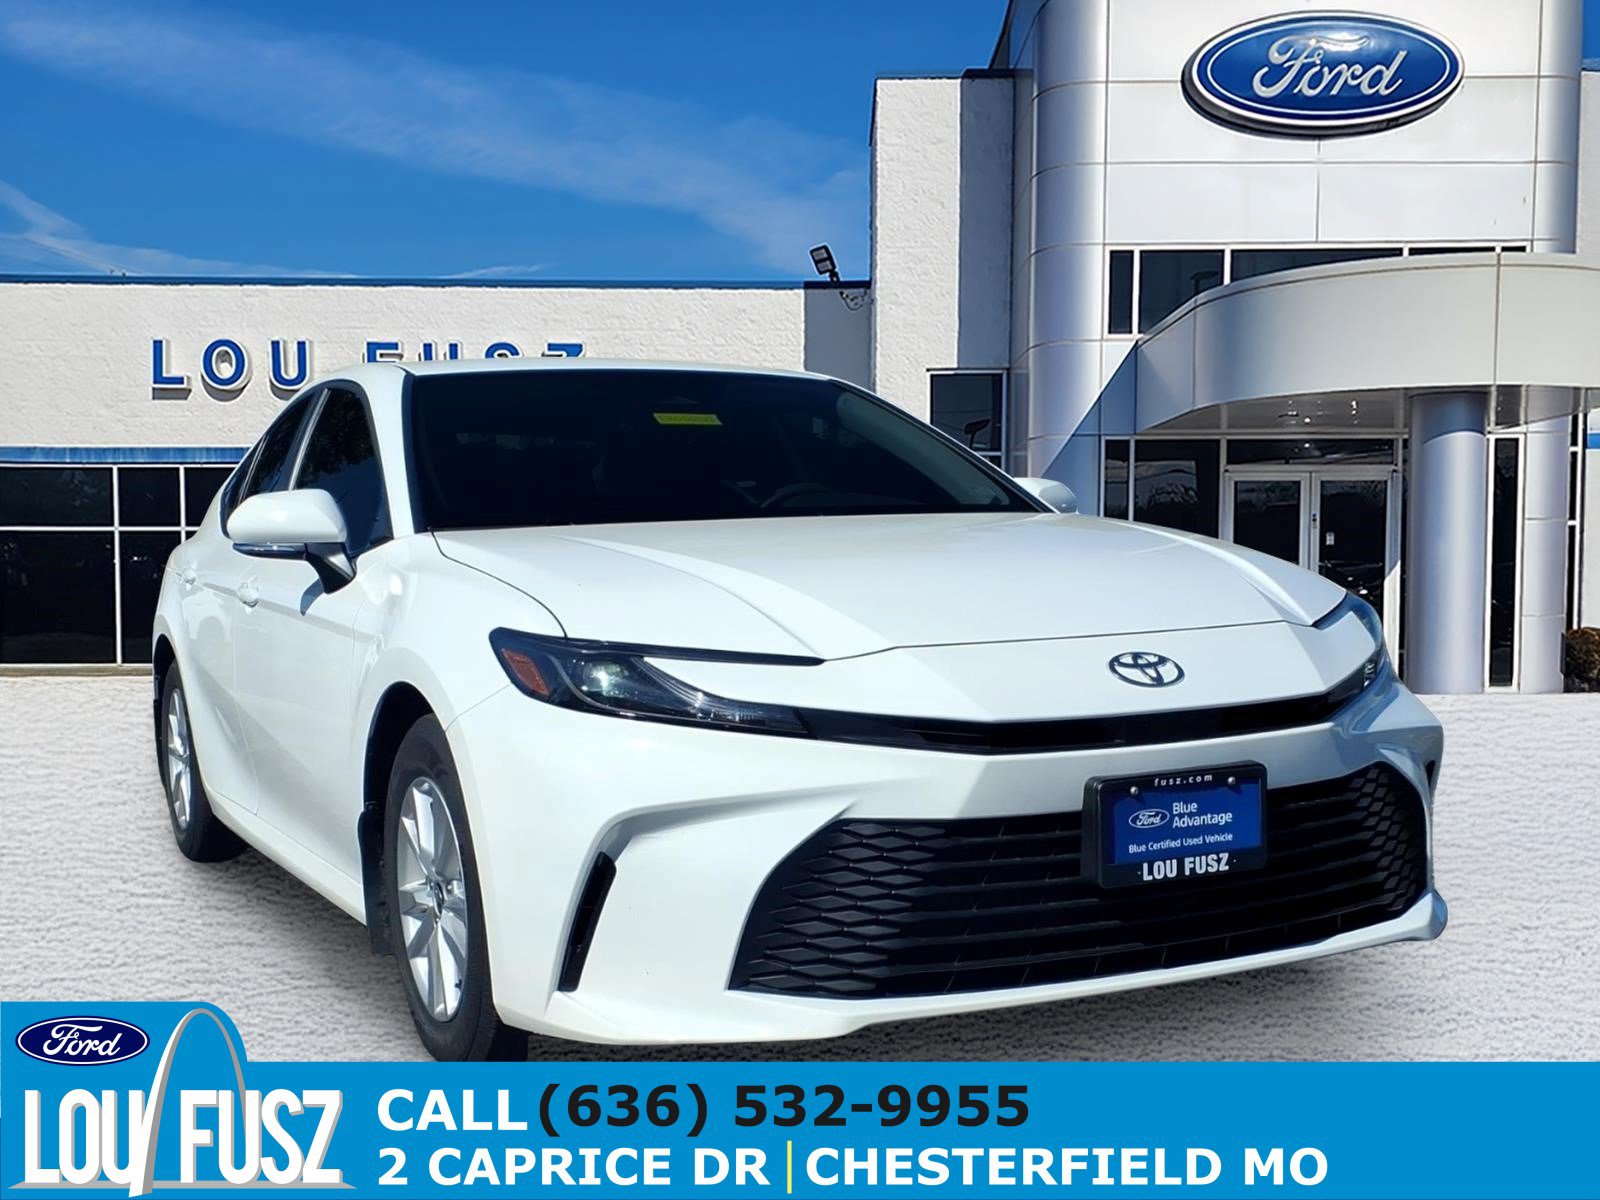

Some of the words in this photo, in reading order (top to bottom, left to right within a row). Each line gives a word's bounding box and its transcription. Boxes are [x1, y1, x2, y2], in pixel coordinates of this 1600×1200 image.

[1252, 34, 1407, 98] Ford
[151, 338, 310, 392] LOU
[1153, 774, 1213, 787] fusz.com
[1172, 801, 1198, 814] Blue
[1136, 811, 1162, 826] Ford
[1172, 812, 1233, 829] Advantage
[1128, 844, 1147, 854] Blue
[1148, 839, 1181, 851] Certified
[1182, 836, 1203, 846] Used
[1204, 832, 1233, 844] Vehicle
[1142, 859, 1177, 881] LOU
[1184, 852, 1230, 876] FUSZ
